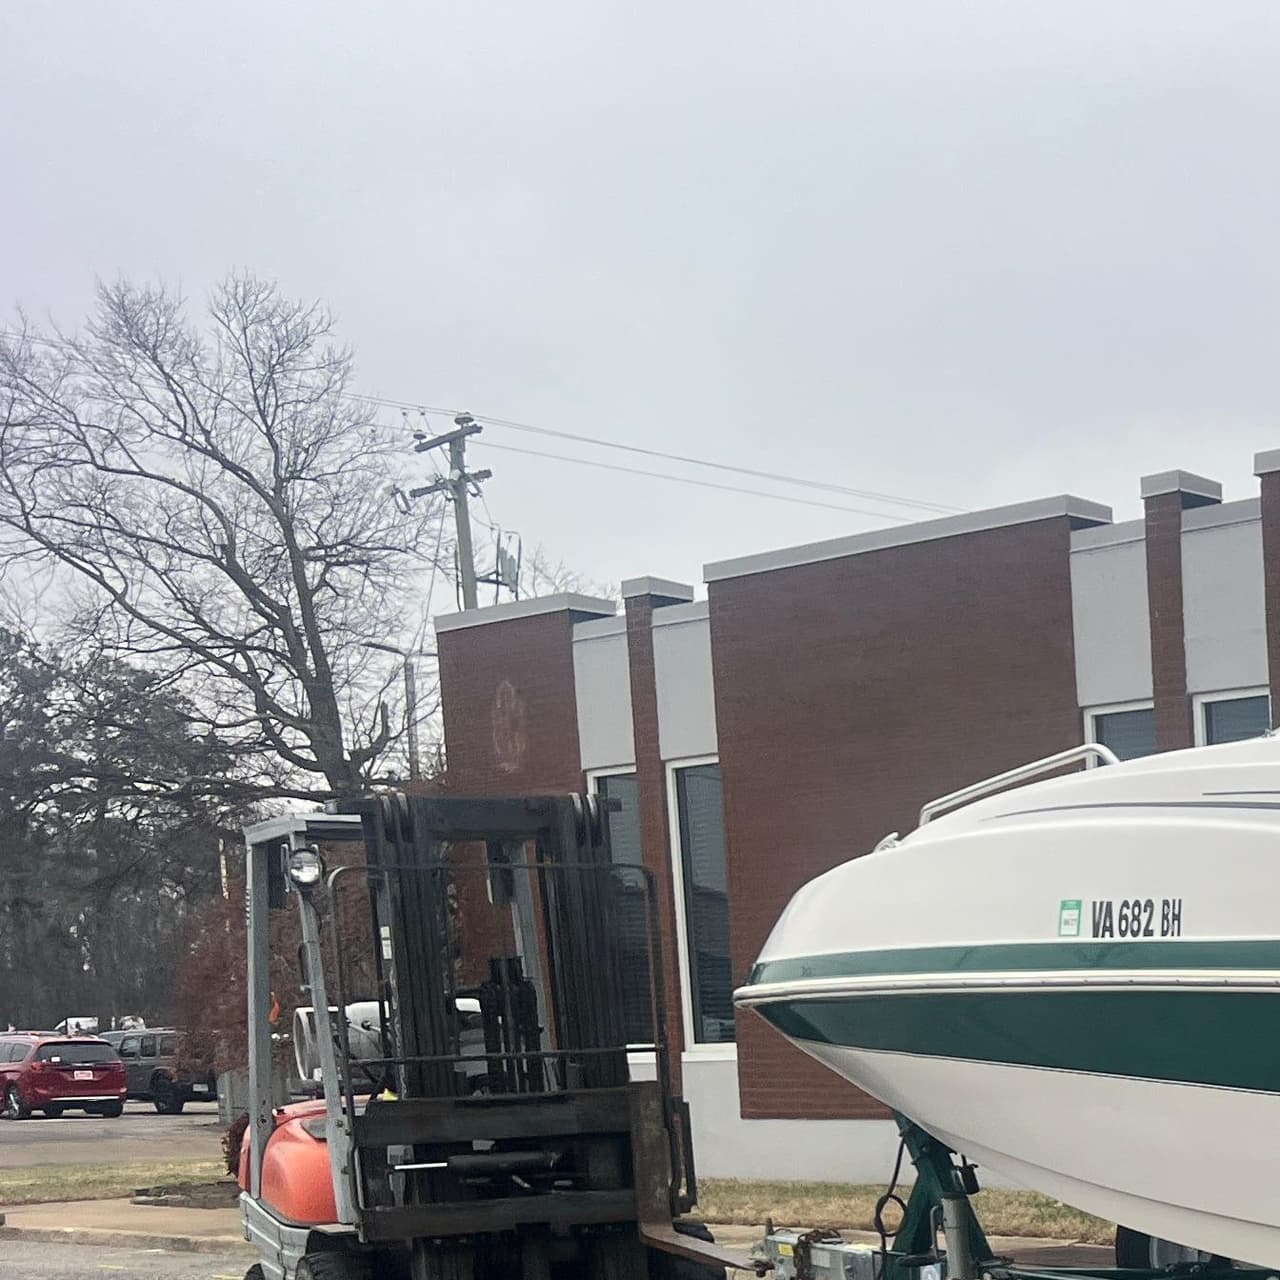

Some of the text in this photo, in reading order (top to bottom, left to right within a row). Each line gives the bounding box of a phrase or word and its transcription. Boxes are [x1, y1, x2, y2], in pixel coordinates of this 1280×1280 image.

[1091, 898, 1182, 938] VA 682 BH
